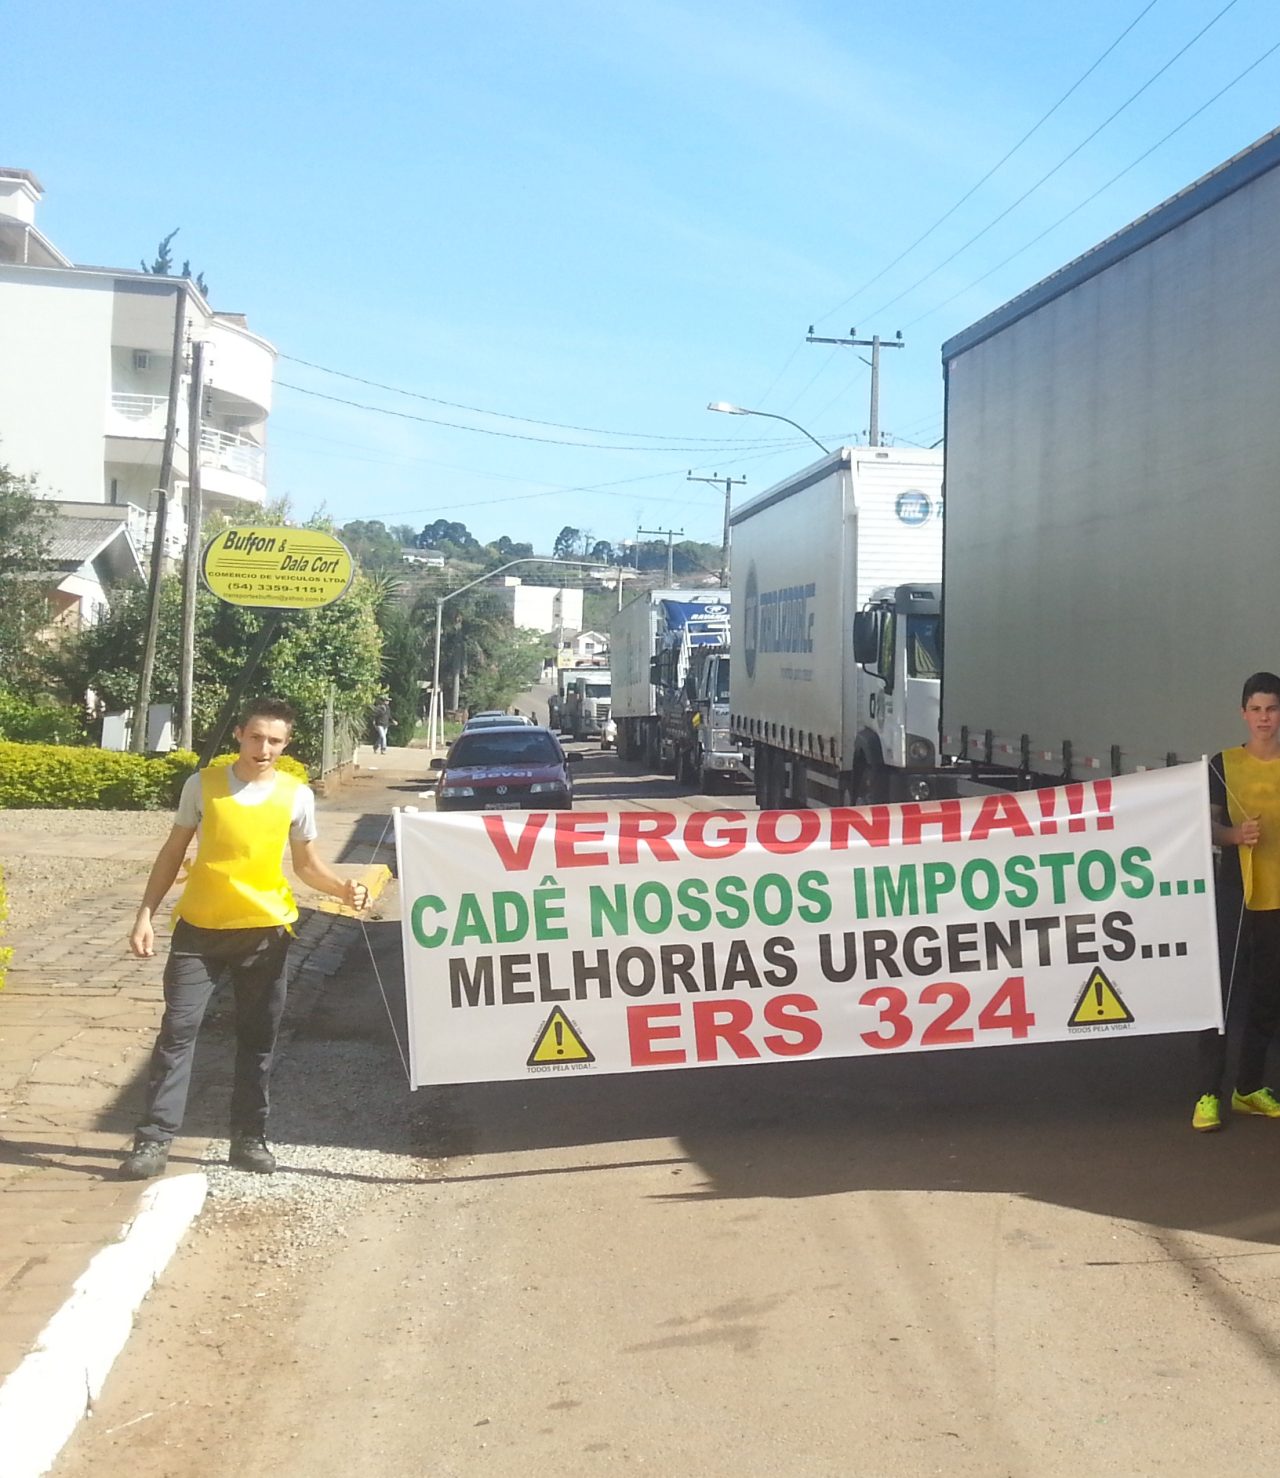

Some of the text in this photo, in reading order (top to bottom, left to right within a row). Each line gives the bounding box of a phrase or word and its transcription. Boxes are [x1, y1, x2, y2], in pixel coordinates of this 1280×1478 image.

[278, 539, 287, 552] &
[280, 555, 339, 573] Dala Cort
[208, 571, 257, 579] COMERCIO
[275, 574, 320, 582] VEICULOS
[227, 583, 324, 593] (54) 3359-1151
[482, 779, 1114, 872] VERGONHA!!!
[411, 846, 1206, 949] CADÊ NOSSOS IMPOSTOS...
[449, 911, 1188, 1008] MELHORIAS URGENTES...
[626, 976, 1035, 1067] ERS 324
[527, 1065, 551, 1074] TODOS
